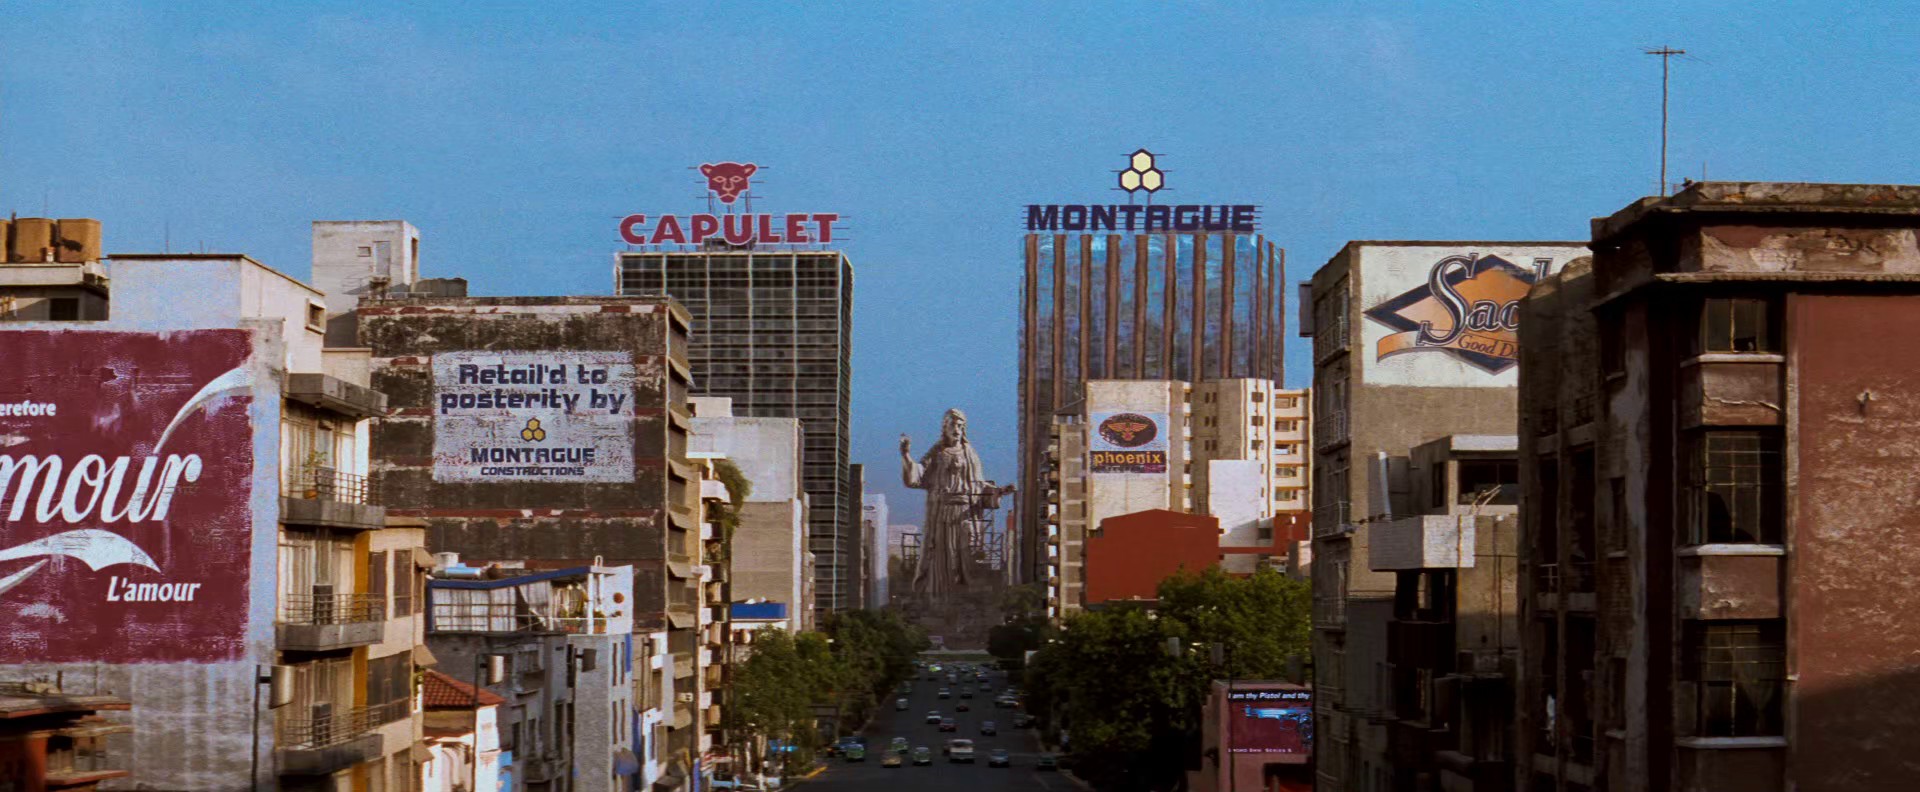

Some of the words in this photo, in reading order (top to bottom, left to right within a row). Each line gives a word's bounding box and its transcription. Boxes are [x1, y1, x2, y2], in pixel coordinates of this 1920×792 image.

[1027, 204, 1255, 231] MONTAGUE
[619, 212, 838, 246] CAPULET
[1458, 334, 1498, 354] Good
[458, 364, 566, 385] Retail'd
[577, 364, 608, 385] to
[440, 388, 580, 414] posterity
[590, 388, 626, 415] by
[470, 448, 596, 463] MONTAGUE
[1093, 451, 1162, 466] phoenix
[480, 466, 585, 476] CONSTRUCTIONS
[107, 575, 201, 602] L'amour
[1246, 692, 1258, 700] thy
[1297, 692, 1310, 700] thy
